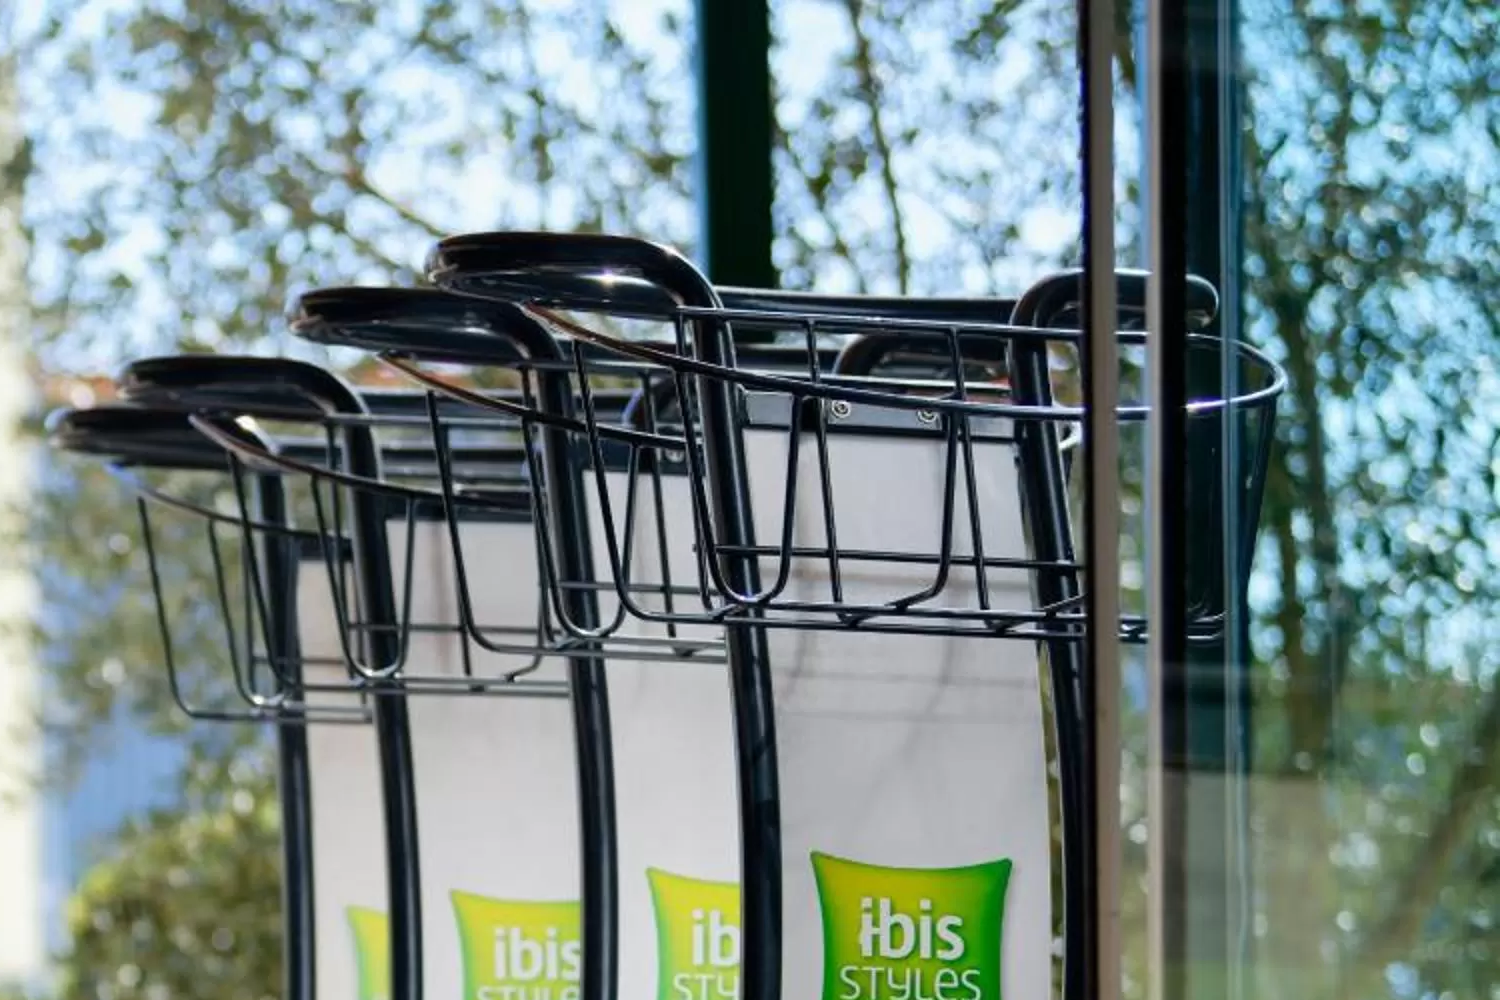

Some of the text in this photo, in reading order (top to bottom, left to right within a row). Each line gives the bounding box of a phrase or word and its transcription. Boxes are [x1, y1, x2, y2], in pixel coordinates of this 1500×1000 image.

[493, 927, 581, 982] ibis
[691, 908, 740, 967] ib
[859, 897, 965, 960] ibis
